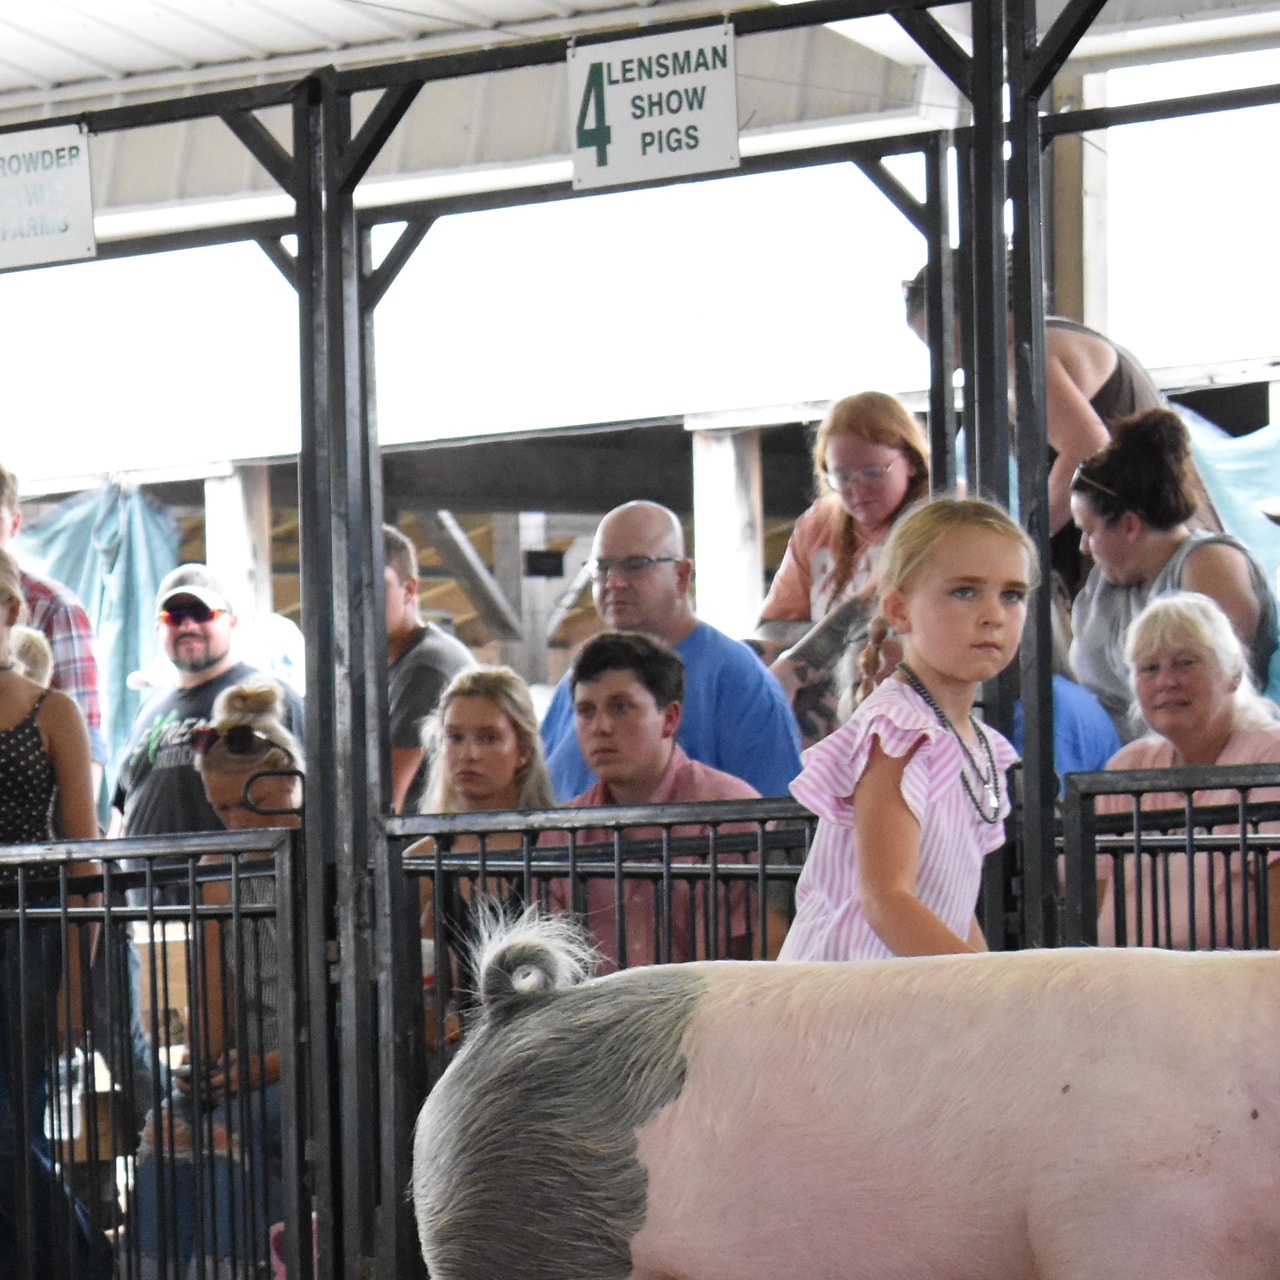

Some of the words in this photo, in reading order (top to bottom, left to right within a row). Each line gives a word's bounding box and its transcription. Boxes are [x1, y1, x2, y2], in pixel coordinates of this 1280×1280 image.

[606, 44, 728, 86] LENSMAN
[576, 61, 611, 167] 4
[630, 85, 706, 119] SHOW
[640, 124, 700, 156] PIGS
